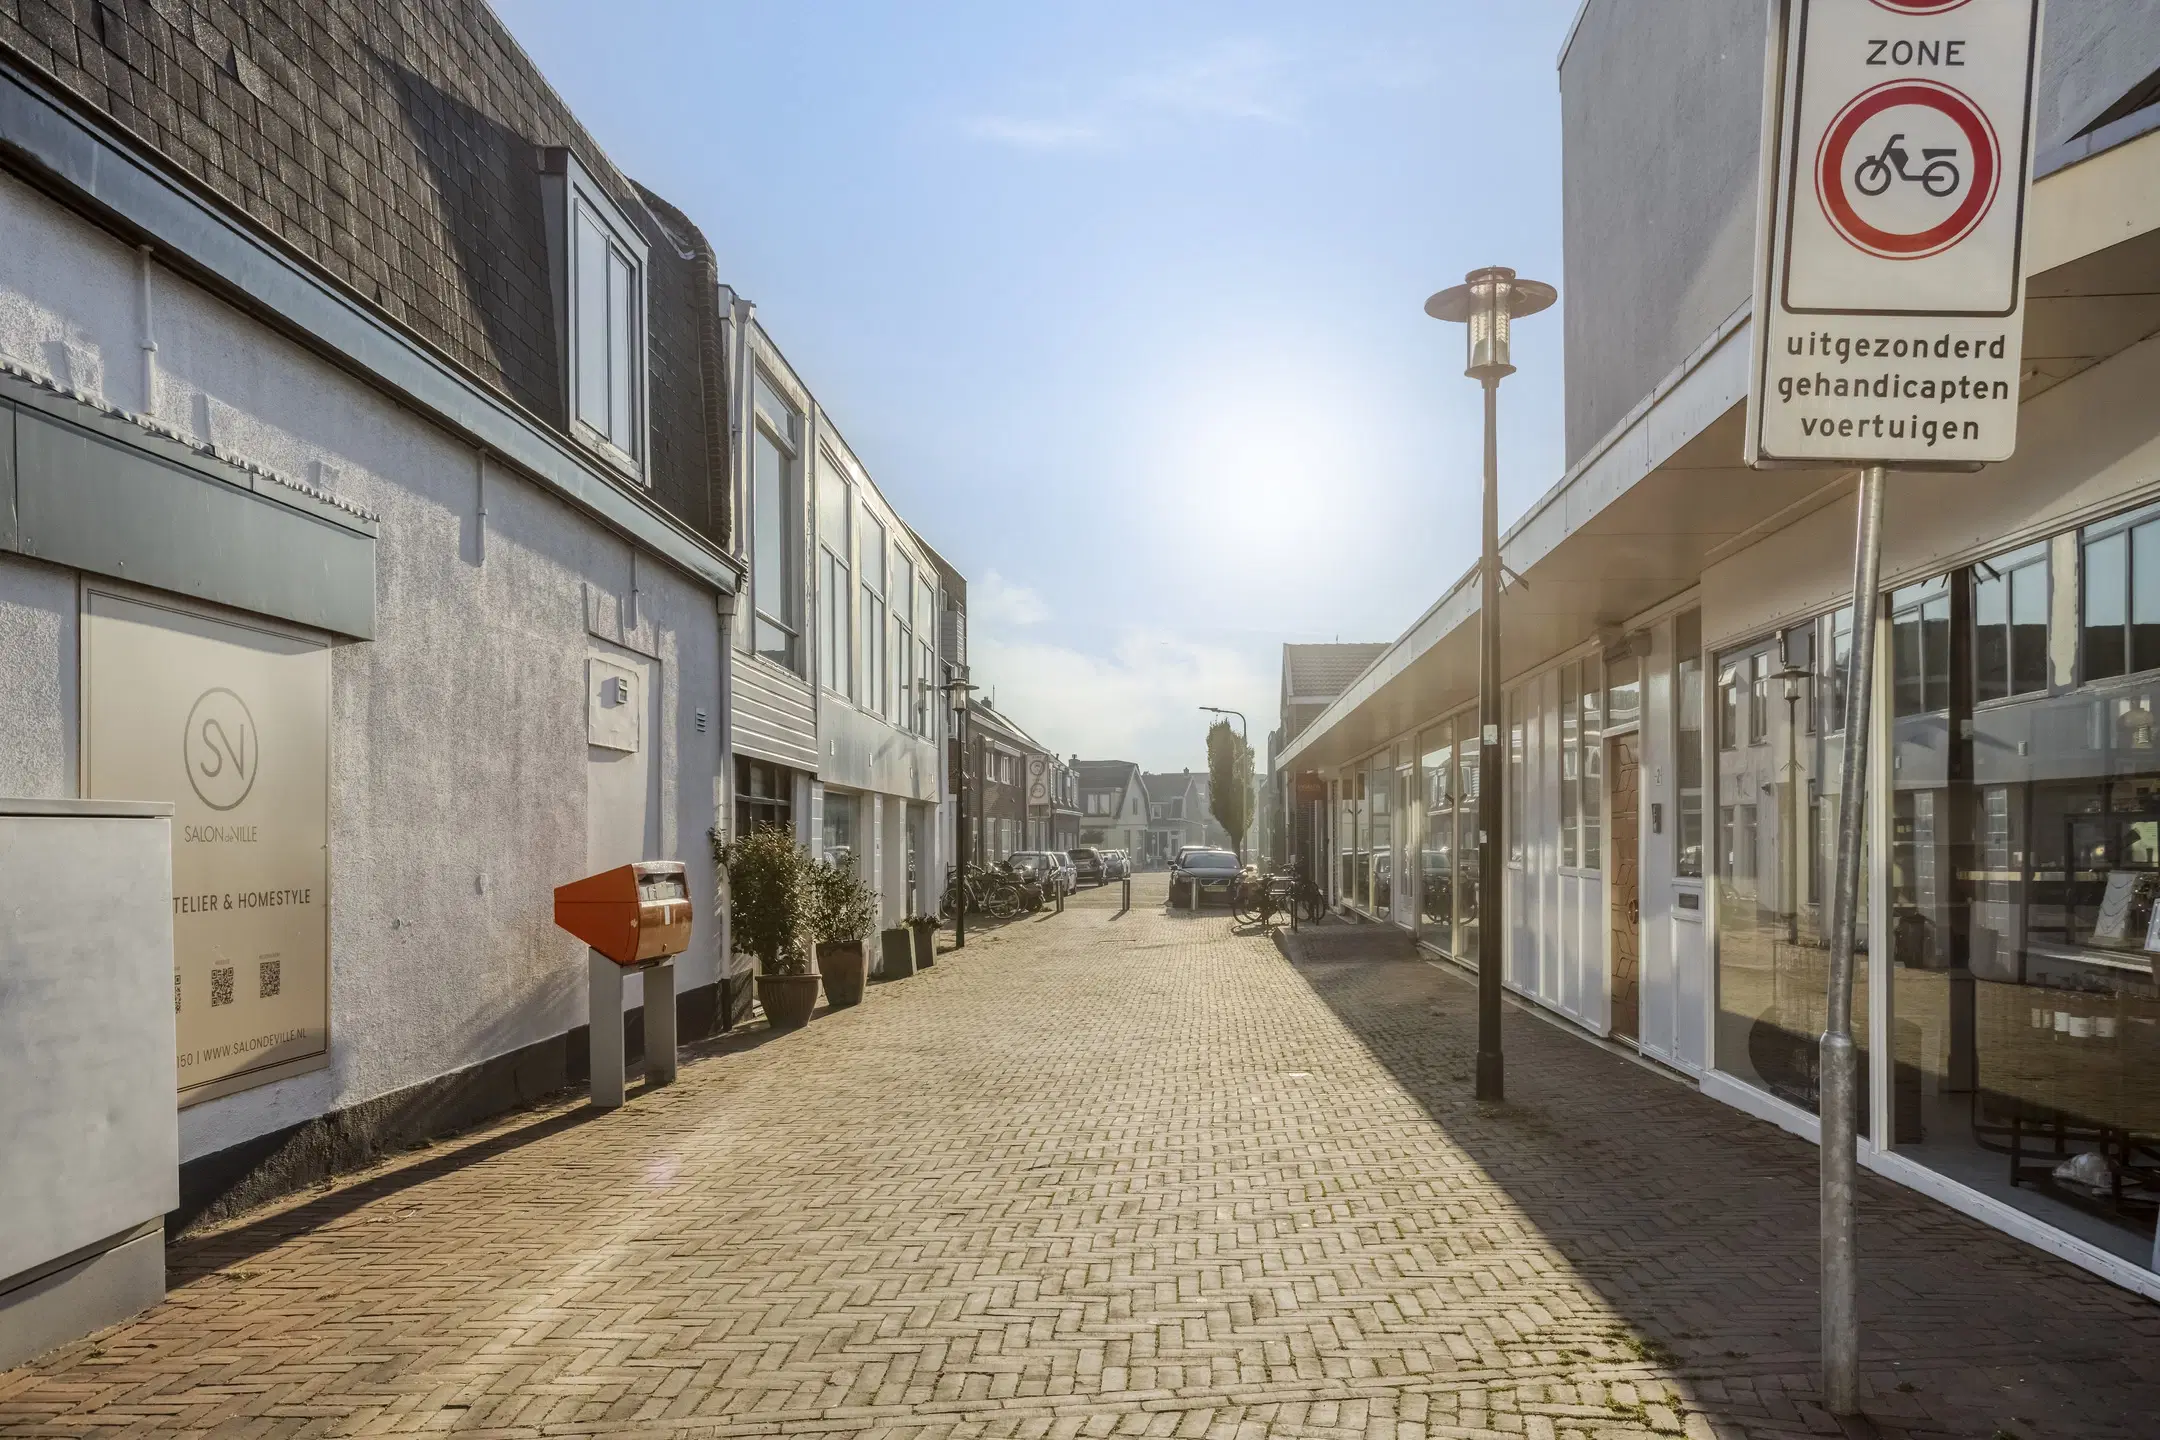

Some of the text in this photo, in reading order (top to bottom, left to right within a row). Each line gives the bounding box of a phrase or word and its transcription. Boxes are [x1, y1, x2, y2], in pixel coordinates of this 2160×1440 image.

[1866, 40, 1966, 66] ZONE
[1787, 331, 2006, 365] uitgezonderd
[1777, 372, 2009, 404] gehandicapten
[1801, 414, 1980, 447] voertuigen
[223, 893, 233, 910] &
[238, 889, 310, 908] HOMESTYLE
[203, 1027, 307, 1062] WWW.SALONDEVILLE.NL
